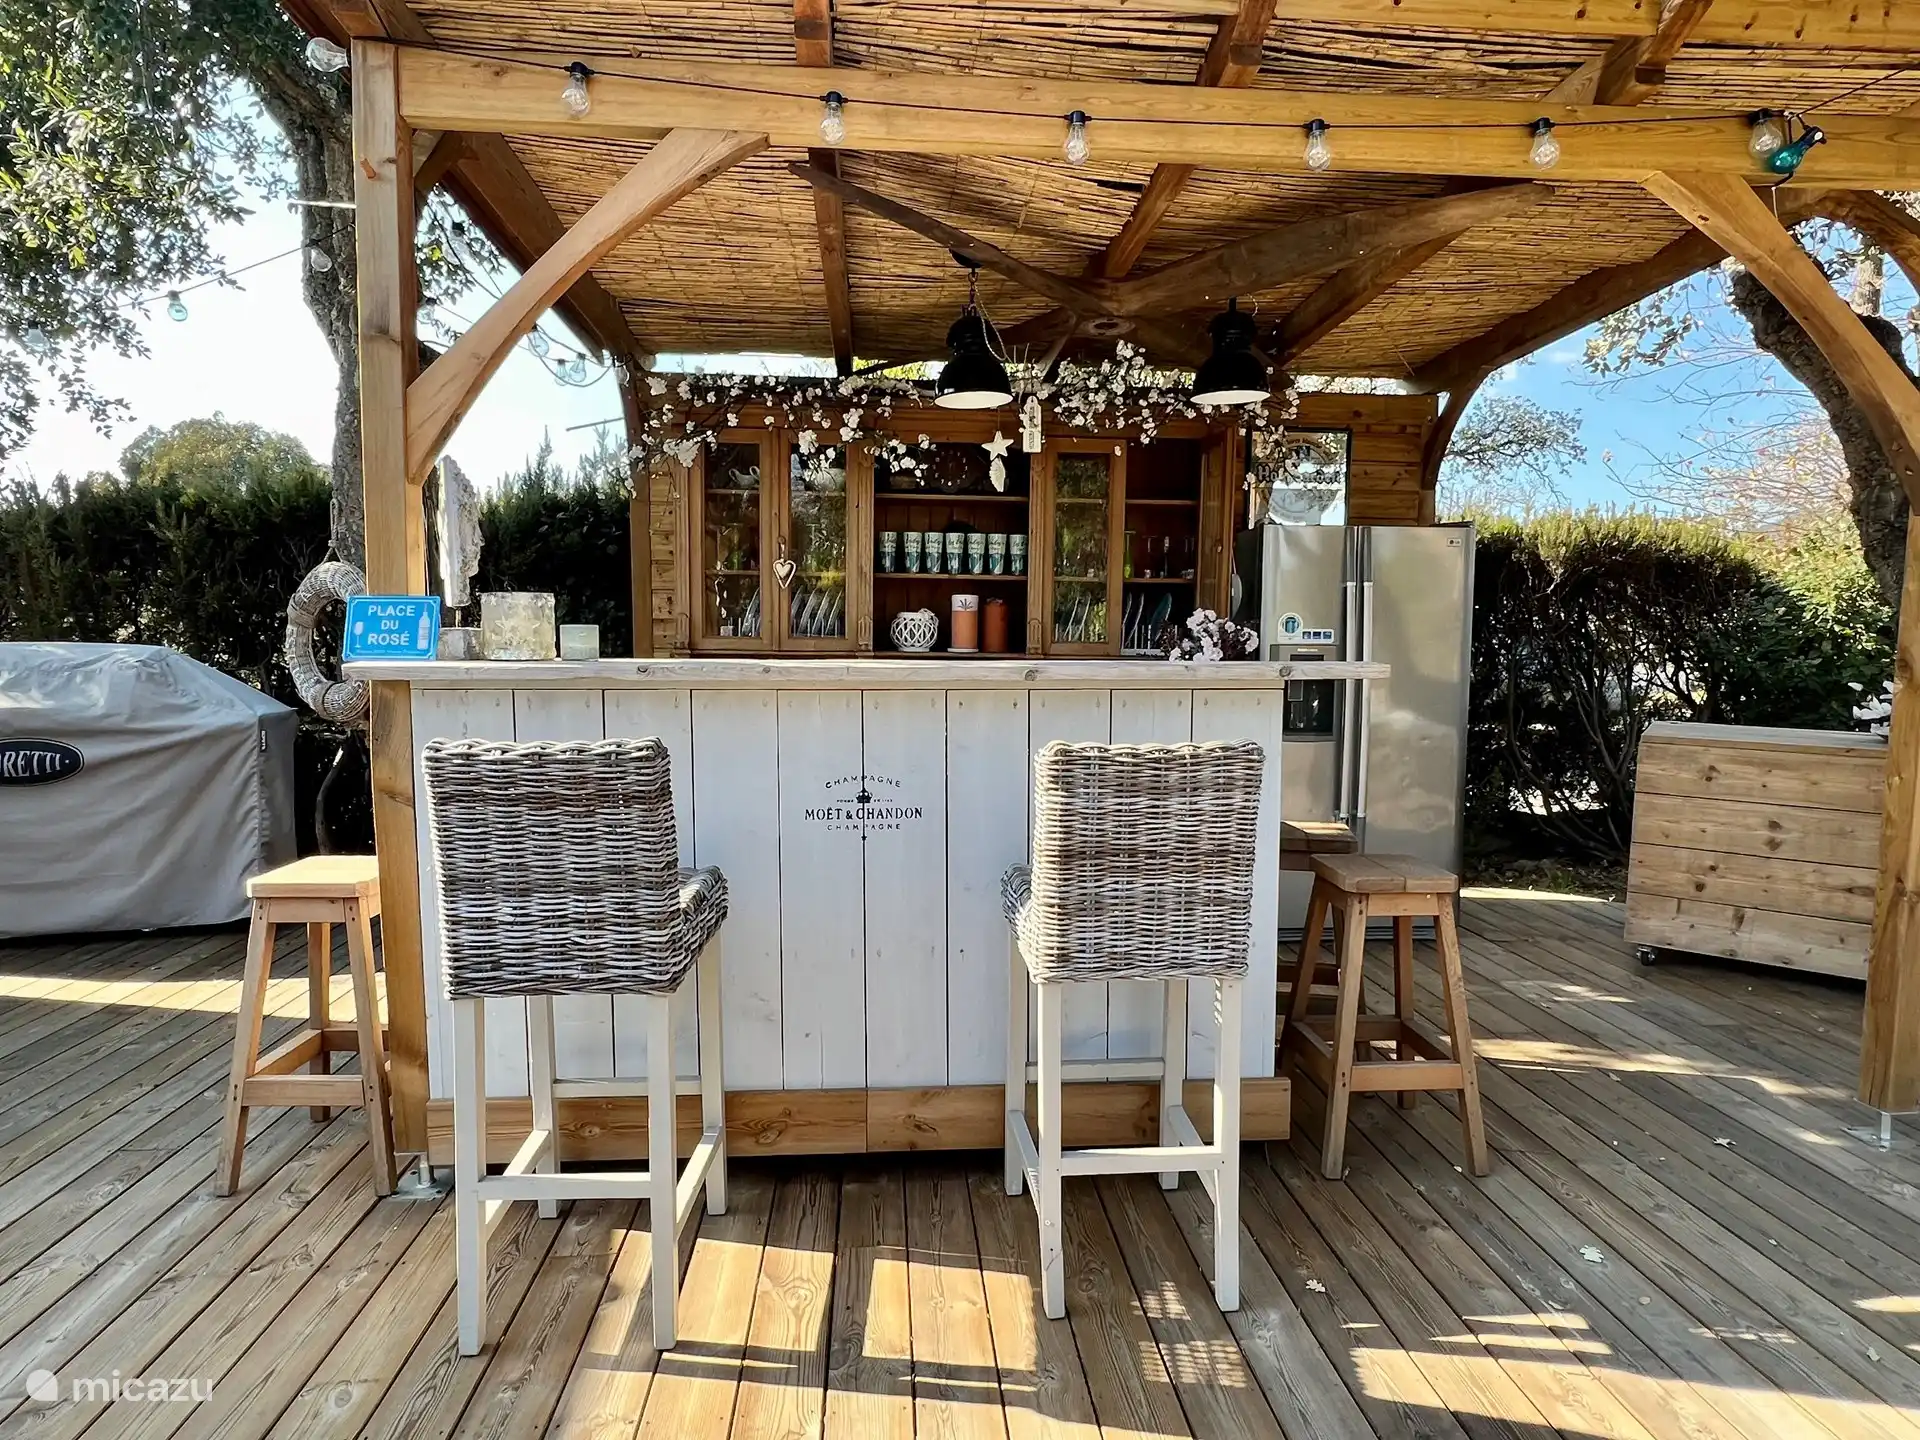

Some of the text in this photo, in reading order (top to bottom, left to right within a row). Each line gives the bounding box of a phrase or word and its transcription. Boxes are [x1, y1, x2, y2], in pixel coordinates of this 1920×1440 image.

[368, 605, 416, 617] PLACE
[381, 620, 399, 630] DU
[367, 631, 410, 646] ROSÉ
[0, 751, 61, 777] RETTI
[825, 775, 901, 789] CHAMPAGNE
[804, 807, 923, 820] MOËT & CHANDON
